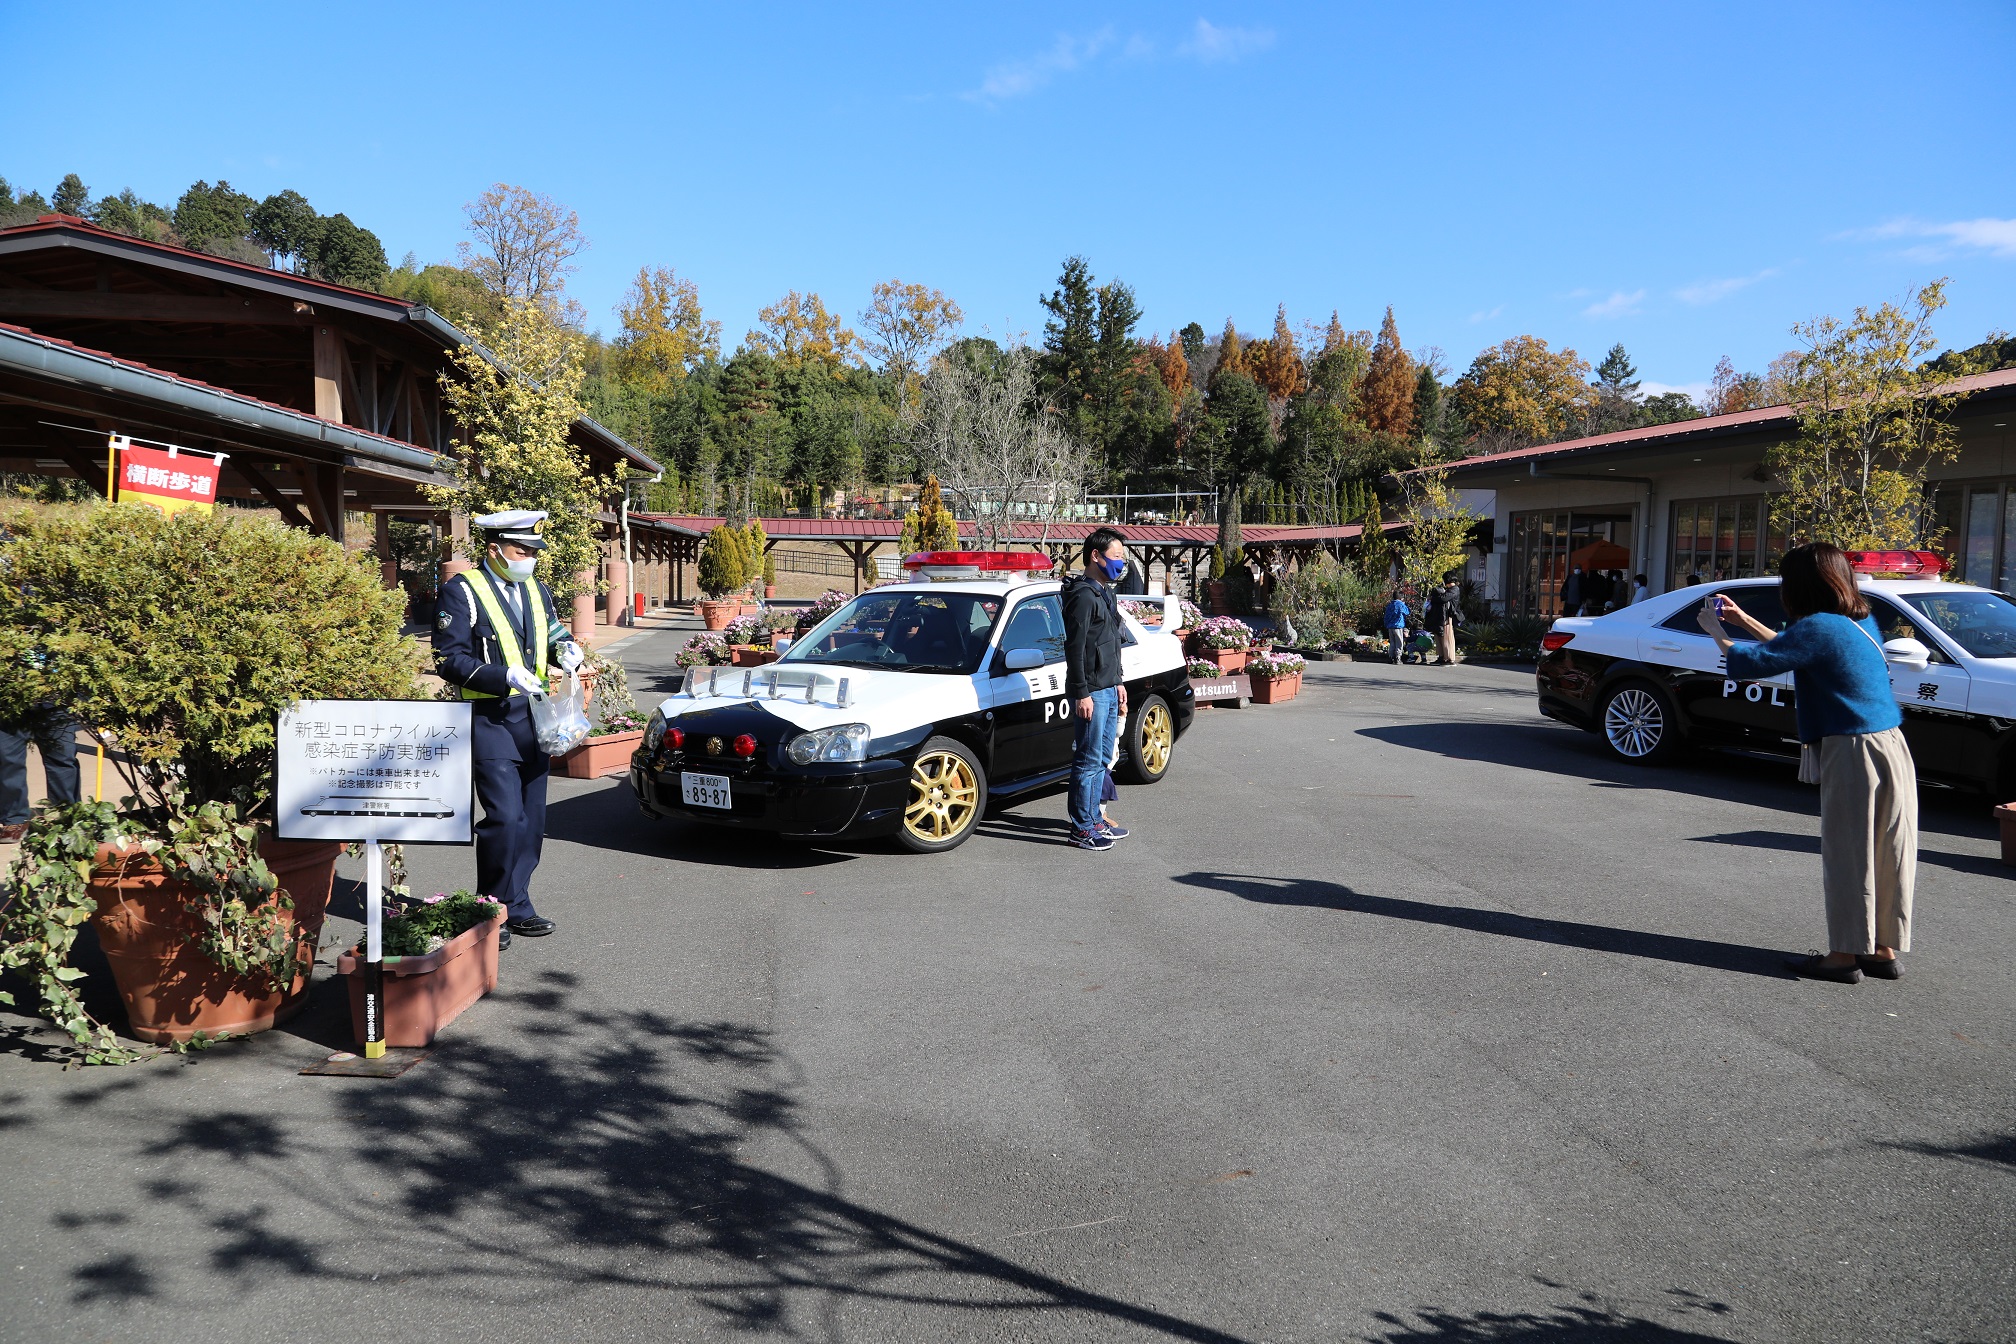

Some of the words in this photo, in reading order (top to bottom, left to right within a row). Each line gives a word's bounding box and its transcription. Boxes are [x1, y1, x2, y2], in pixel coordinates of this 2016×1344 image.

[126, 463, 212, 495] 横断歩道
[295, 721, 459, 739] 新型コロナウイルス
[304, 742, 450, 761] 感染症予防実施中
